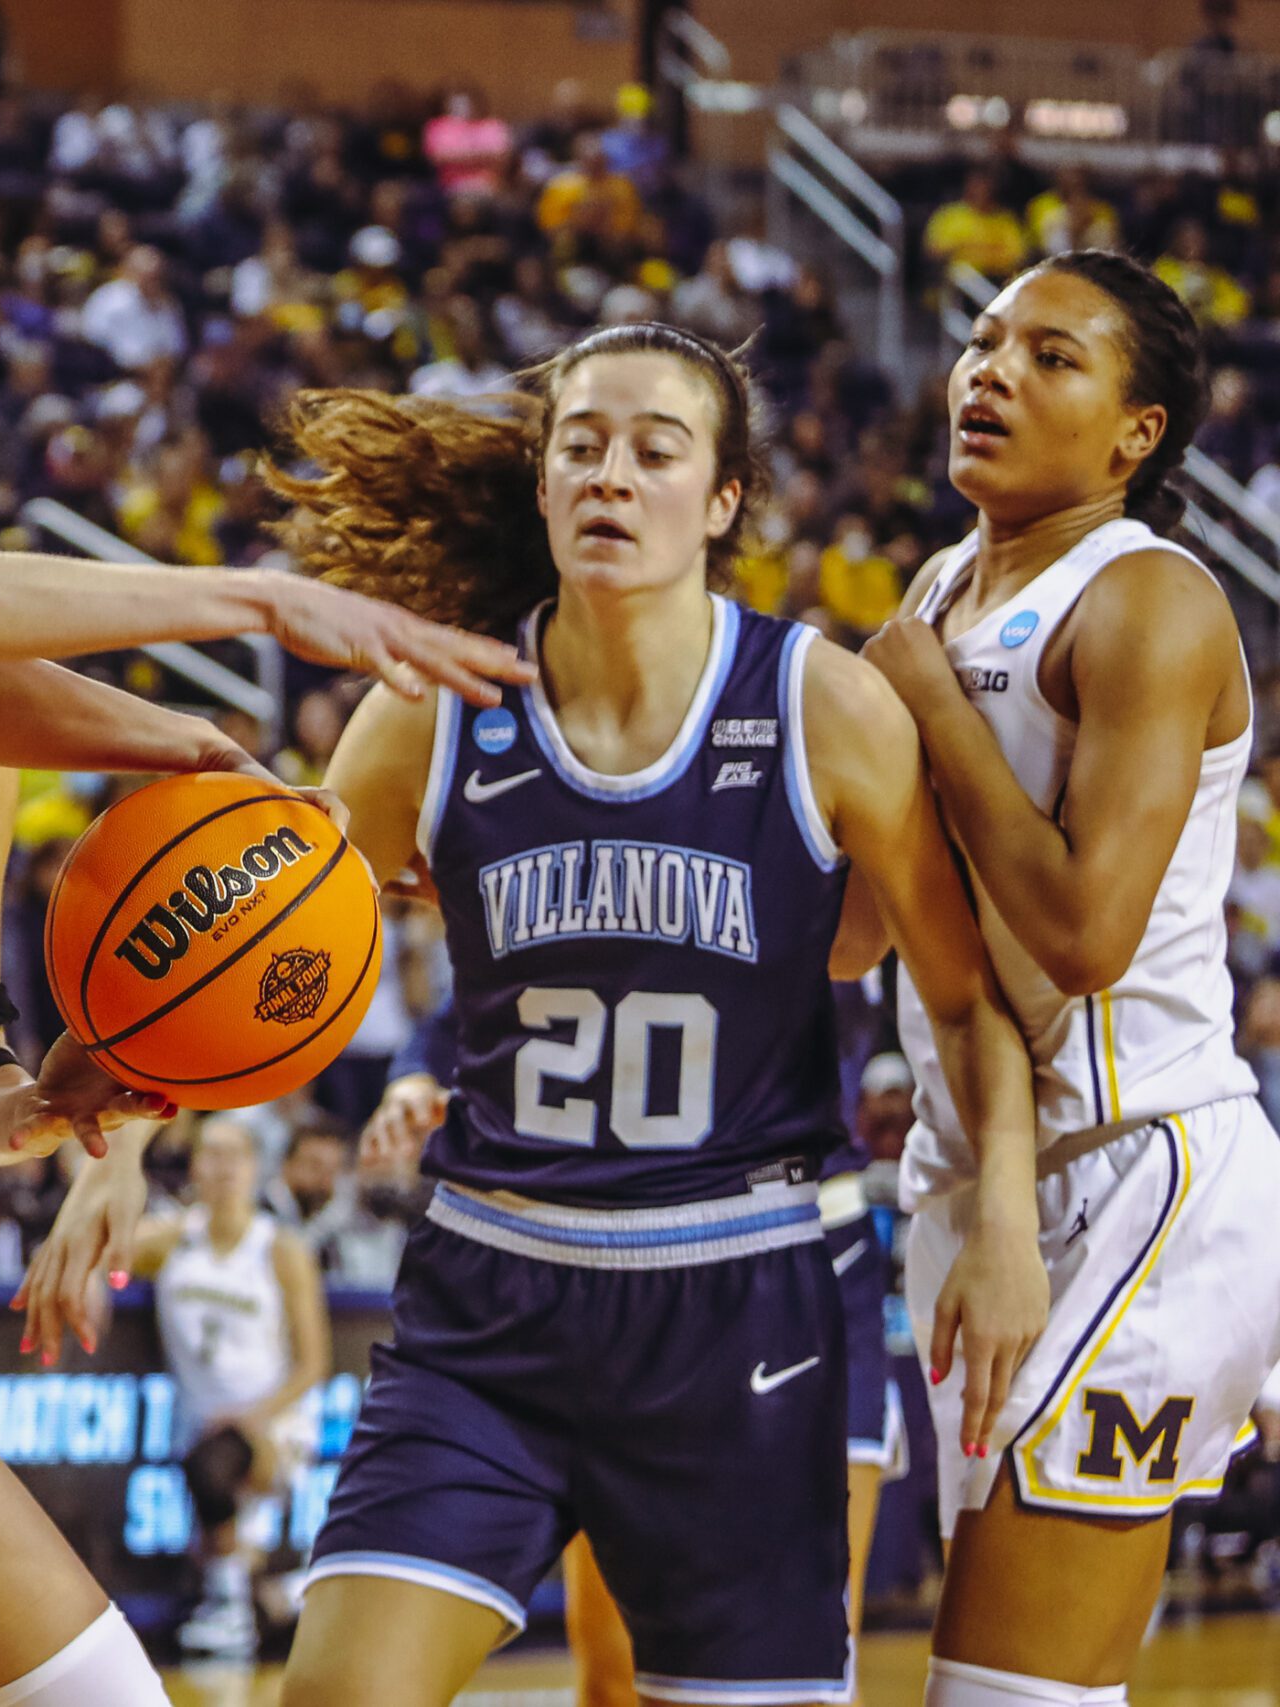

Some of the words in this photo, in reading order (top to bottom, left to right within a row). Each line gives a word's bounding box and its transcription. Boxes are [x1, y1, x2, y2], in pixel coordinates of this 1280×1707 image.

[711, 734, 778, 748] CHANGE
[714, 771, 763, 785] EAST
[113, 825, 314, 980] Wilson
[212, 916, 239, 943] EVO
[241, 887, 267, 917] NXT
[479, 839, 758, 964] VILLANOVA
[259, 985, 298, 1018] FINAL
[295, 956, 328, 991] FOUR
[514, 986, 719, 1149] 20
[1075, 1387, 1197, 1484] M
